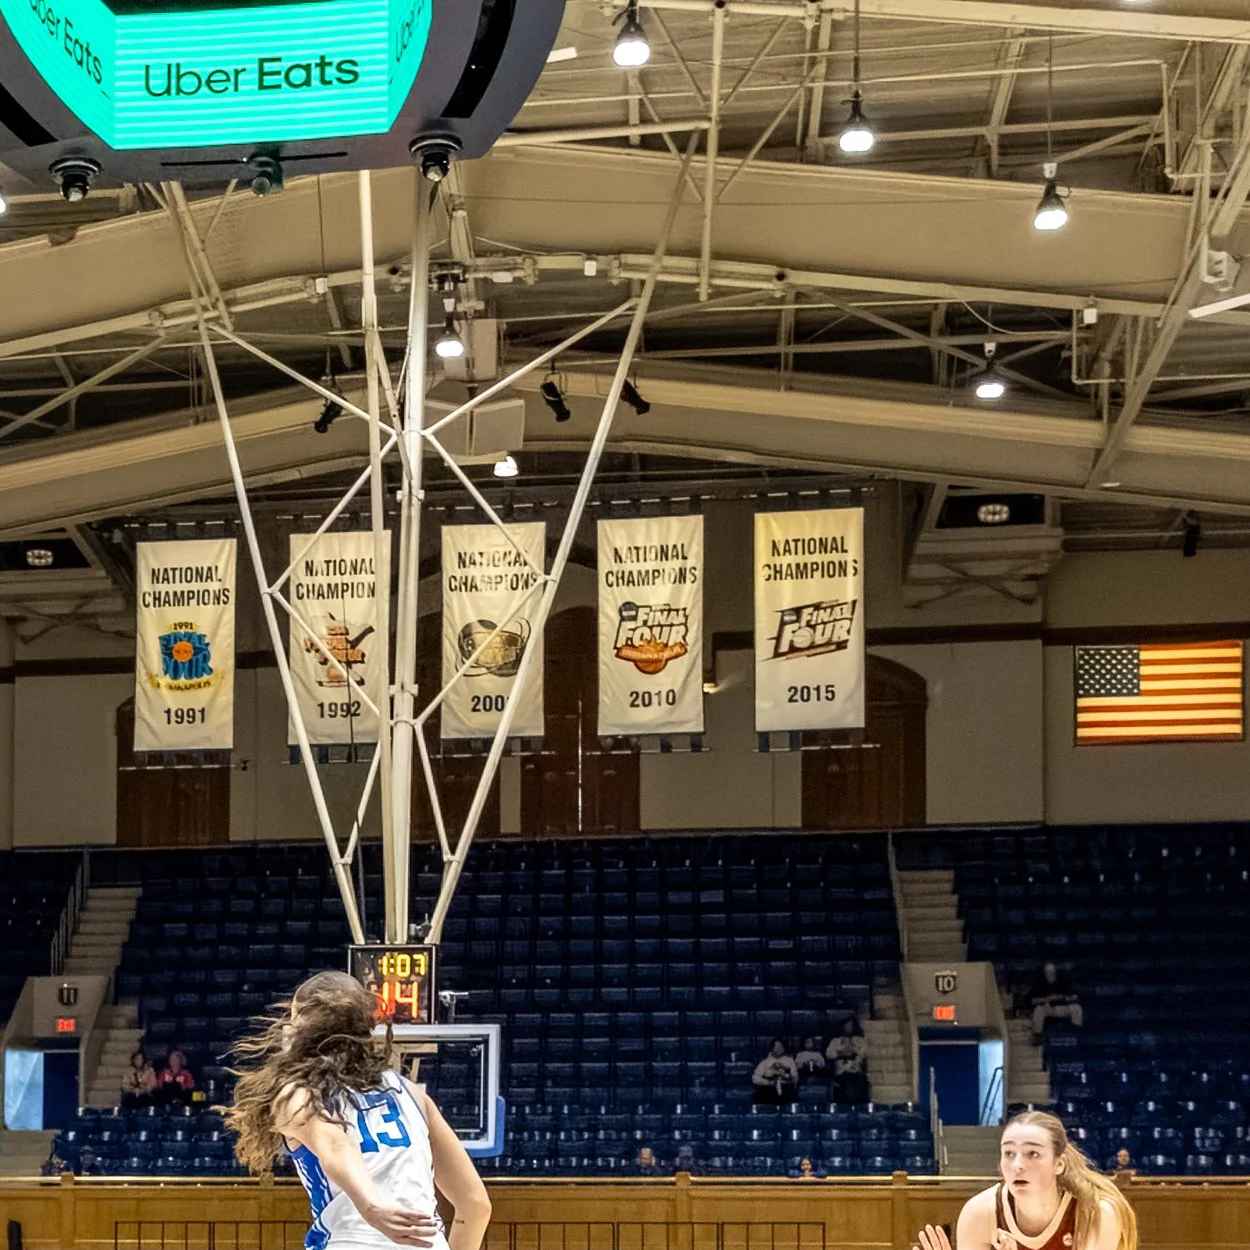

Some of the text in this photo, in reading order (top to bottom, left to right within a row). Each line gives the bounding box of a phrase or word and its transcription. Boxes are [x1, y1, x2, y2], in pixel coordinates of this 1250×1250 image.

[64, 16, 102, 84] Eats
[143, 54, 359, 98] Uber Eats
[613, 543, 688, 564] NATIONAL
[771, 536, 848, 557] NATIONAL
[151, 566, 223, 585] NATIONAL
[304, 558, 376, 578] NATIONAL
[605, 566, 698, 588] CHAMPIONS
[762, 559, 858, 581] CHAMPIONS
[295, 581, 376, 602] CHAMPION
[448, 572, 538, 593] CHAMPIONS
[142, 587, 230, 608] CHAMPIONS
[173, 621, 193, 631] 1991
[636, 607, 687, 627] FINAL
[616, 620, 687, 649] FOUR
[471, 694, 510, 712] 200
[629, 689, 676, 708] 2010
[787, 684, 836, 703] 2015
[163, 707, 205, 725] 1991
[317, 701, 361, 719] 1992
[381, 954, 427, 978] 1:07
[938, 976, 955, 991] 10
[356, 1093, 412, 1153] 13
